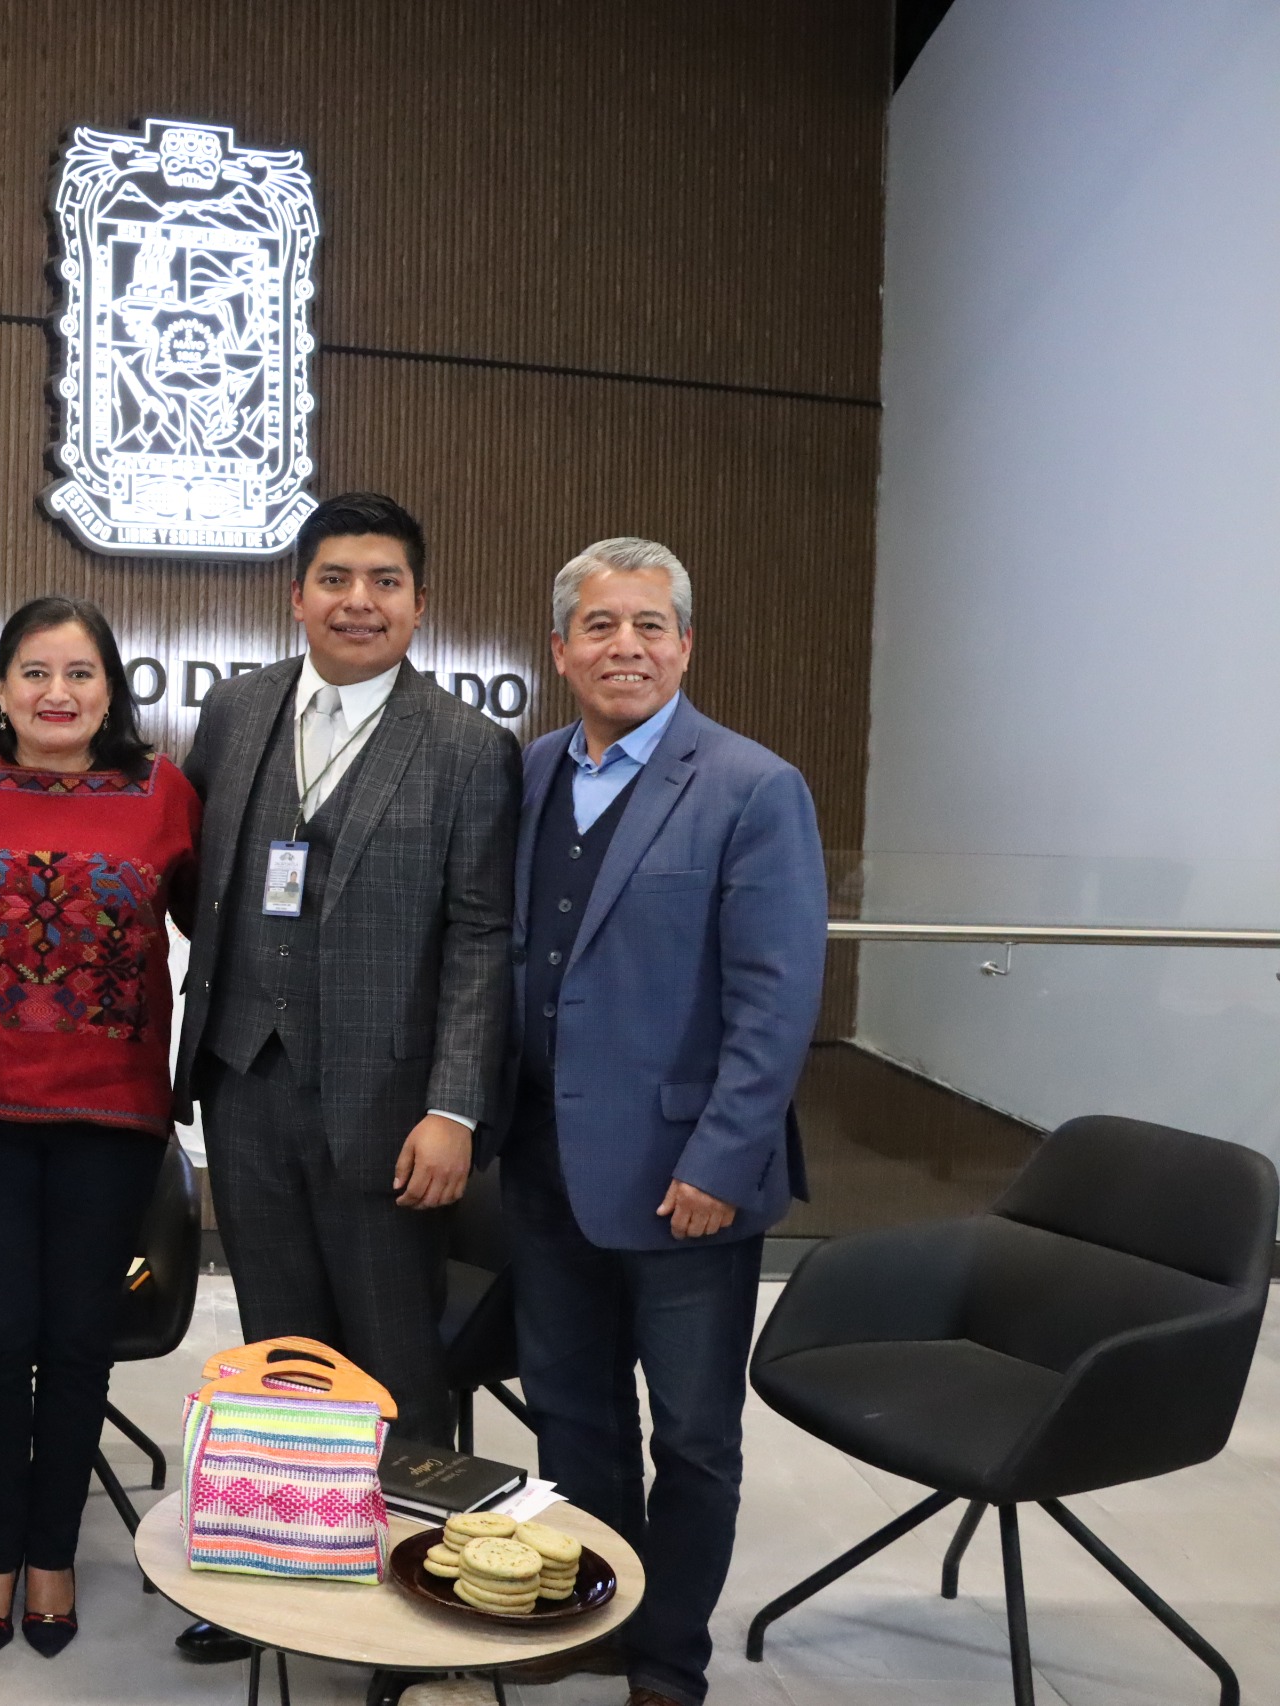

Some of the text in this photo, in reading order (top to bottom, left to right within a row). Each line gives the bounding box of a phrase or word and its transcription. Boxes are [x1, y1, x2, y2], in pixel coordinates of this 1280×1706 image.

[173, 339, 206, 351] MAYO
[268, 339, 280, 450] JUSTICIA
[64, 487, 312, 547] ESTADO LIBRE Y SOBERANO DE PUEBLA
